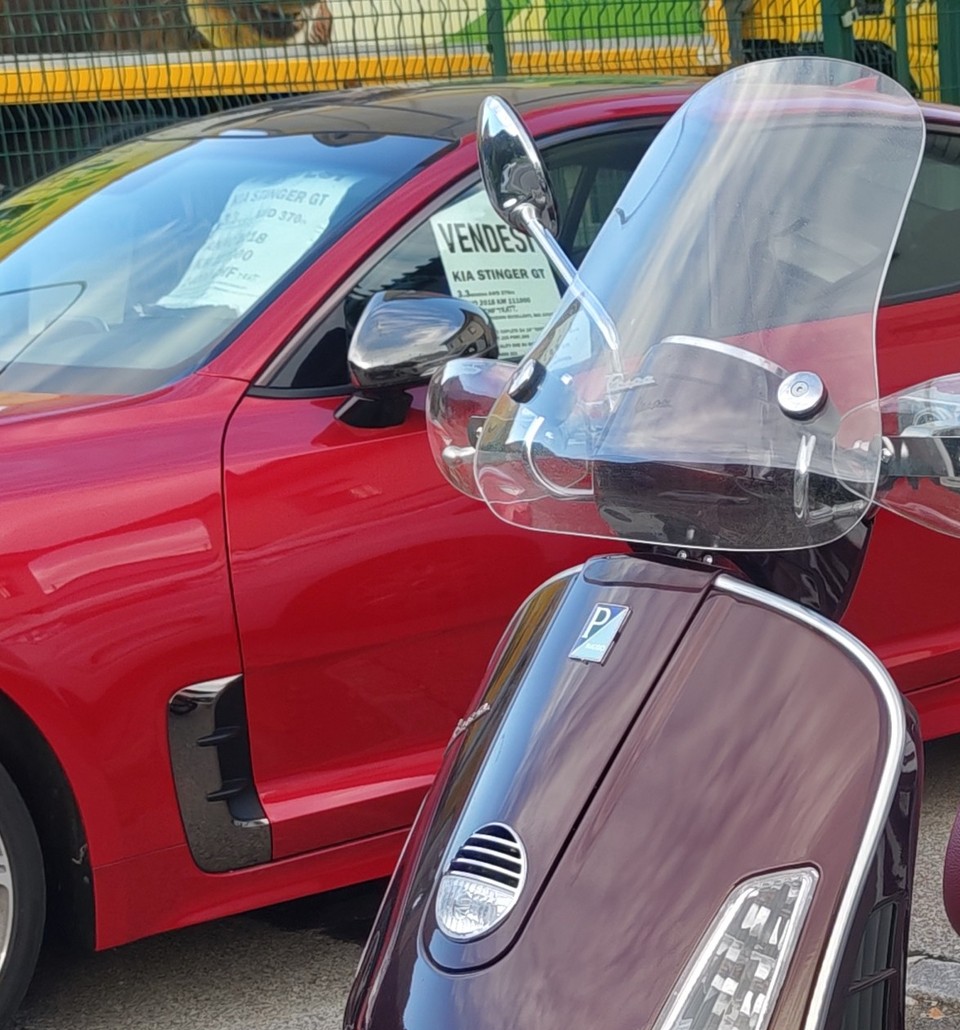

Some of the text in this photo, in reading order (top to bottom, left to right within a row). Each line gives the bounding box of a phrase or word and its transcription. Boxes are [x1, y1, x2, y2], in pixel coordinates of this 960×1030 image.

[308, 192, 330, 207] GT
[452, 268, 546, 282] KIA STINGER GT
[582, 606, 612, 639] P
